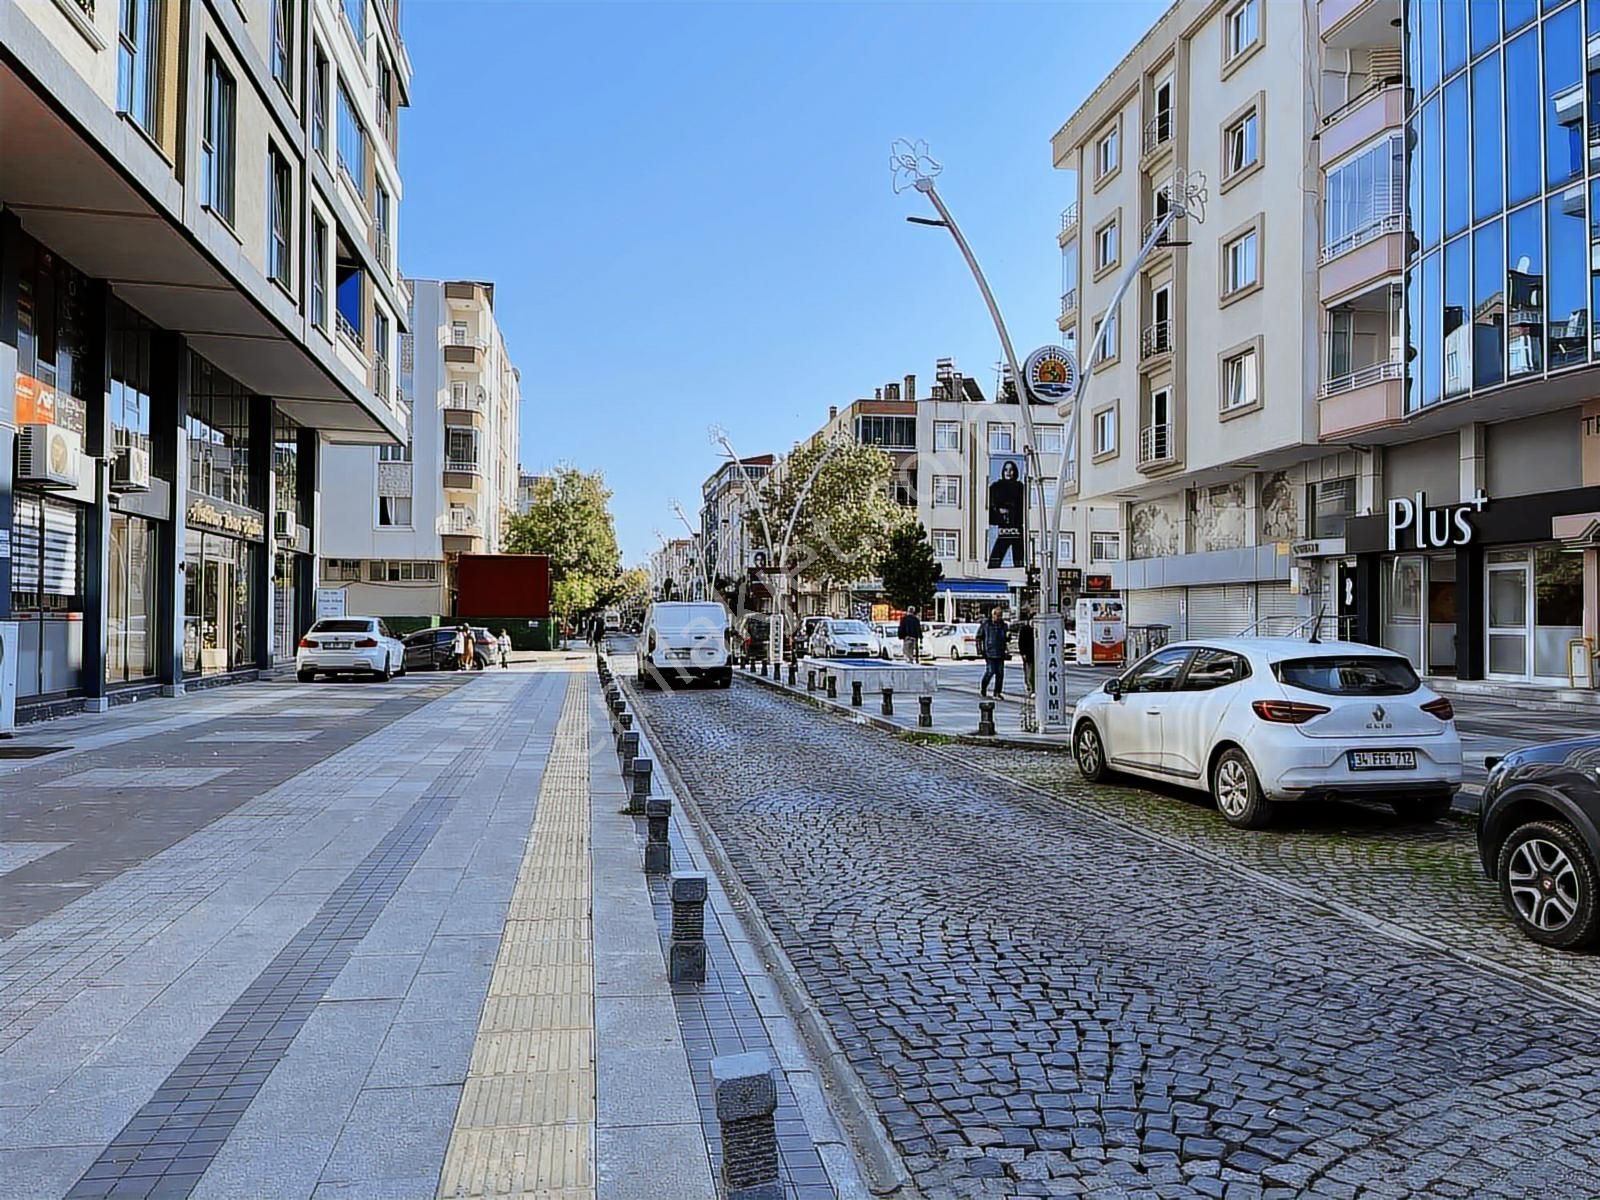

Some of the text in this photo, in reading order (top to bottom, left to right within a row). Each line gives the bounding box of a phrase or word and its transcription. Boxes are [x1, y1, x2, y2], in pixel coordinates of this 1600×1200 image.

[1048, 629, 1060, 710] ATAKUM
[1355, 751, 1413, 766] 34 FFG 712
